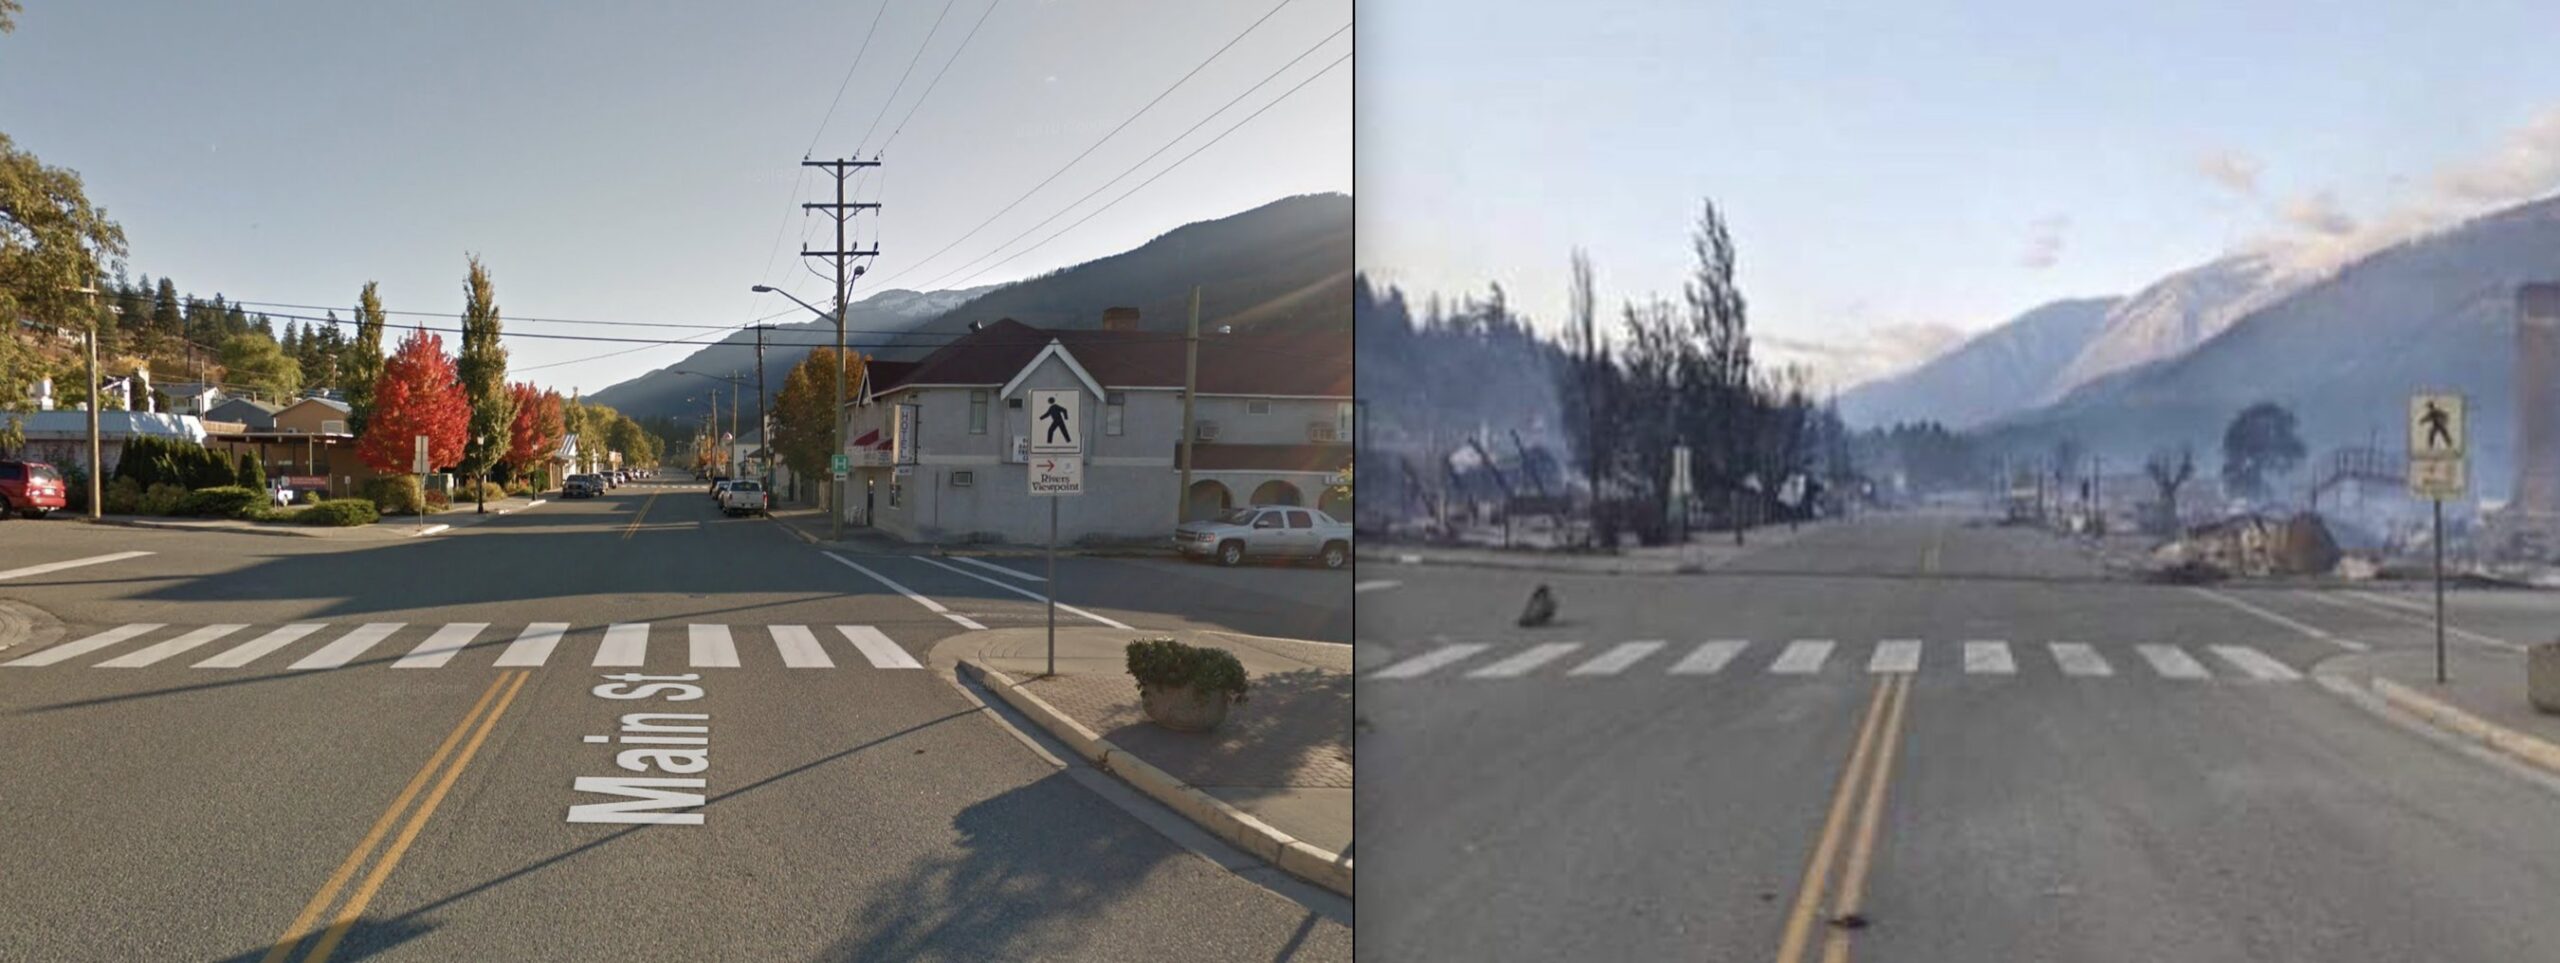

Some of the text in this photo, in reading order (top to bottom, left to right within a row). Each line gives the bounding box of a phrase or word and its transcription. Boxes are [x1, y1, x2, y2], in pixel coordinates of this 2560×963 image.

[901, 411, 909, 459] HOTEL
[834, 457, 847, 470] H
[1041, 473, 1070, 483] Rivers
[1032, 481, 1079, 492] Viewpoint
